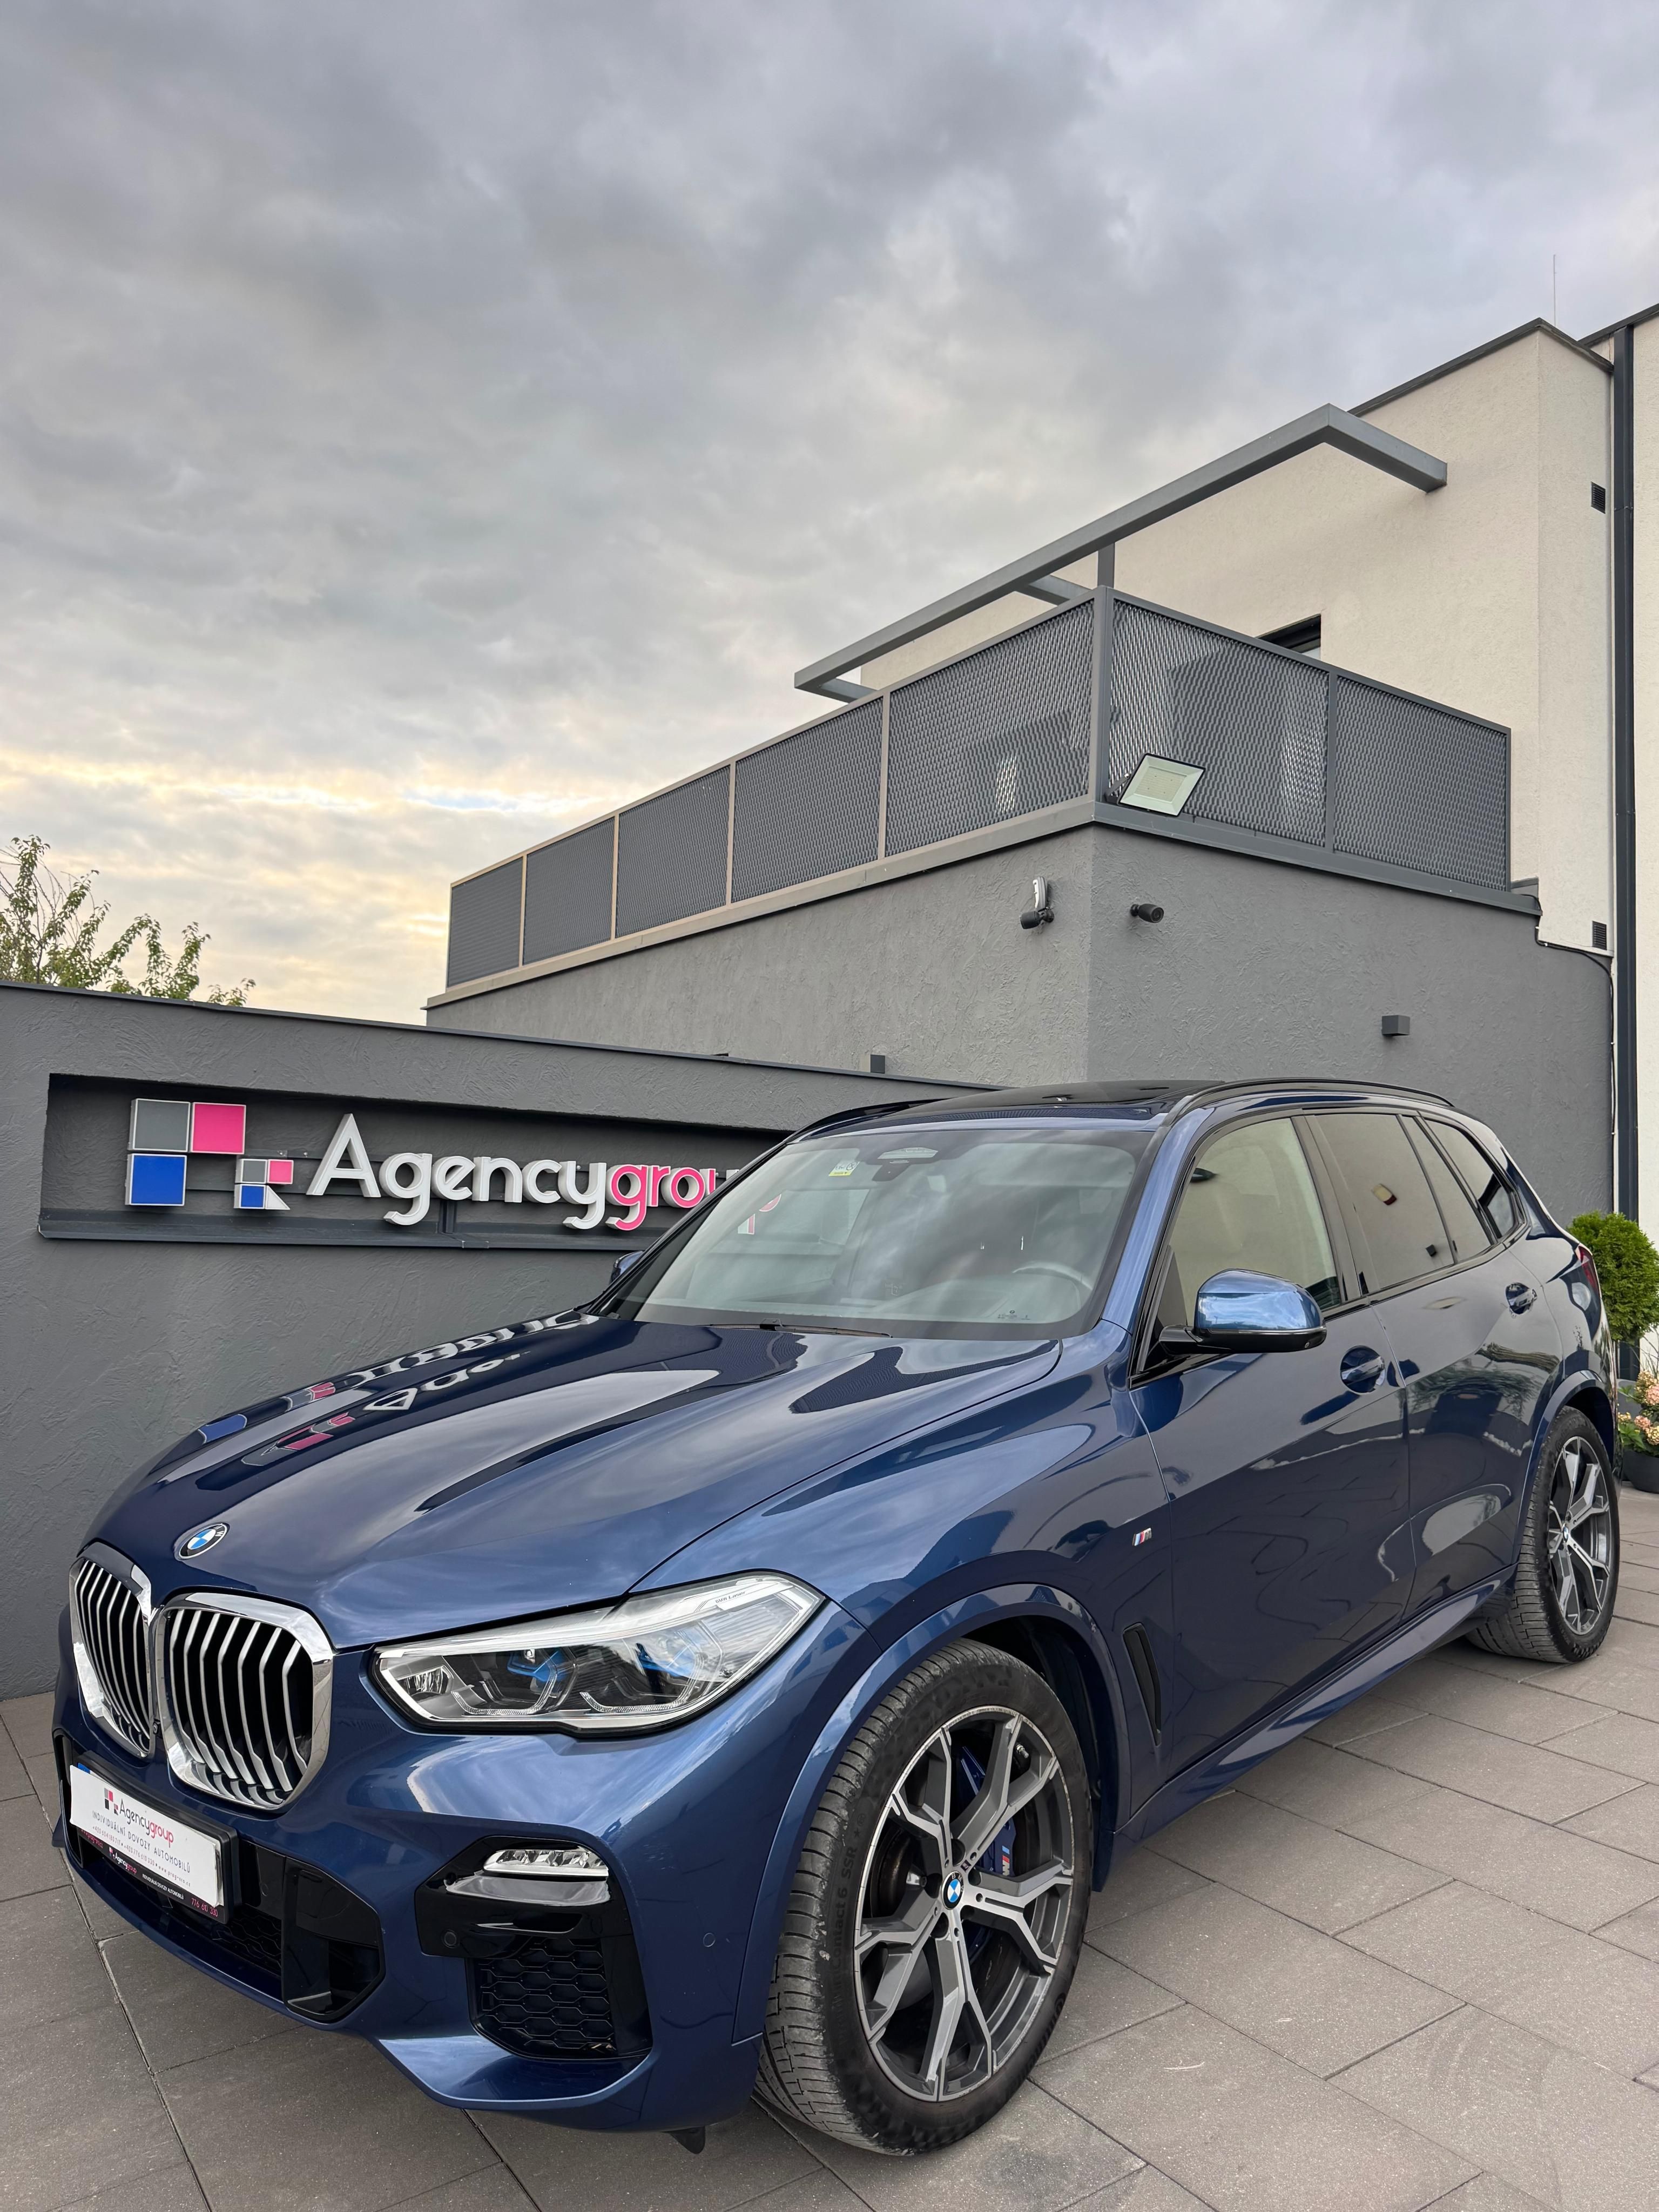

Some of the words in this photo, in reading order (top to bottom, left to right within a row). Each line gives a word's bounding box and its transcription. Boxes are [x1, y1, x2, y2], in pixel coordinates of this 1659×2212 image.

[306, 1112, 781, 1234] Agencygro
[729, 1591, 745, 1599] Laser
[92, 1810, 125, 1836] INDIVIDUÁLNÍ
[128, 1831, 150, 1851] DOVOZY
[154, 1847, 190, 1873] AUTOMOBILŮ
[119, 1798, 174, 1848] Agencygroup
[841, 1846, 858, 1879] SSR
[191, 1898, 200, 1908] 776
[210, 1906, 218, 1917] 330
